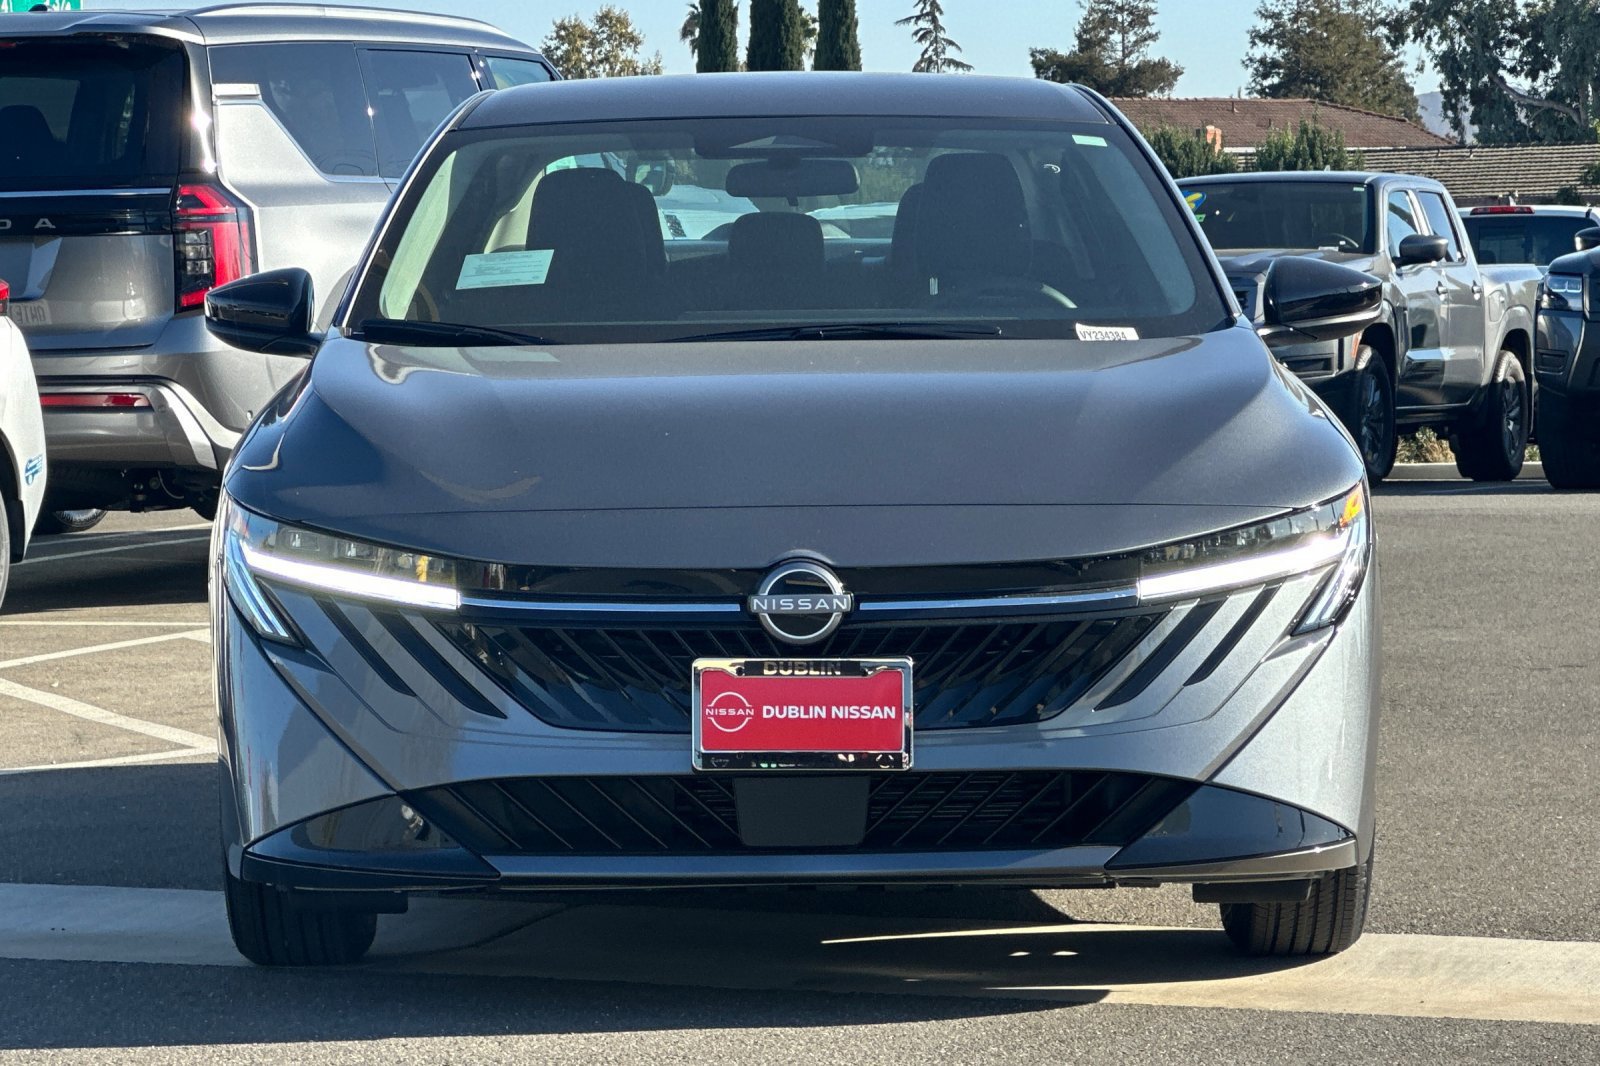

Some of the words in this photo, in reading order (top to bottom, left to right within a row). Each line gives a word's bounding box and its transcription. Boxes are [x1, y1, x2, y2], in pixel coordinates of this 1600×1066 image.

[753, 598, 847, 610] NISSAN
[763, 661, 841, 676] DUBLIN
[705, 707, 754, 716] NISSAN
[762, 705, 826, 719] DUBLIN
[832, 705, 896, 719] NISSAN
